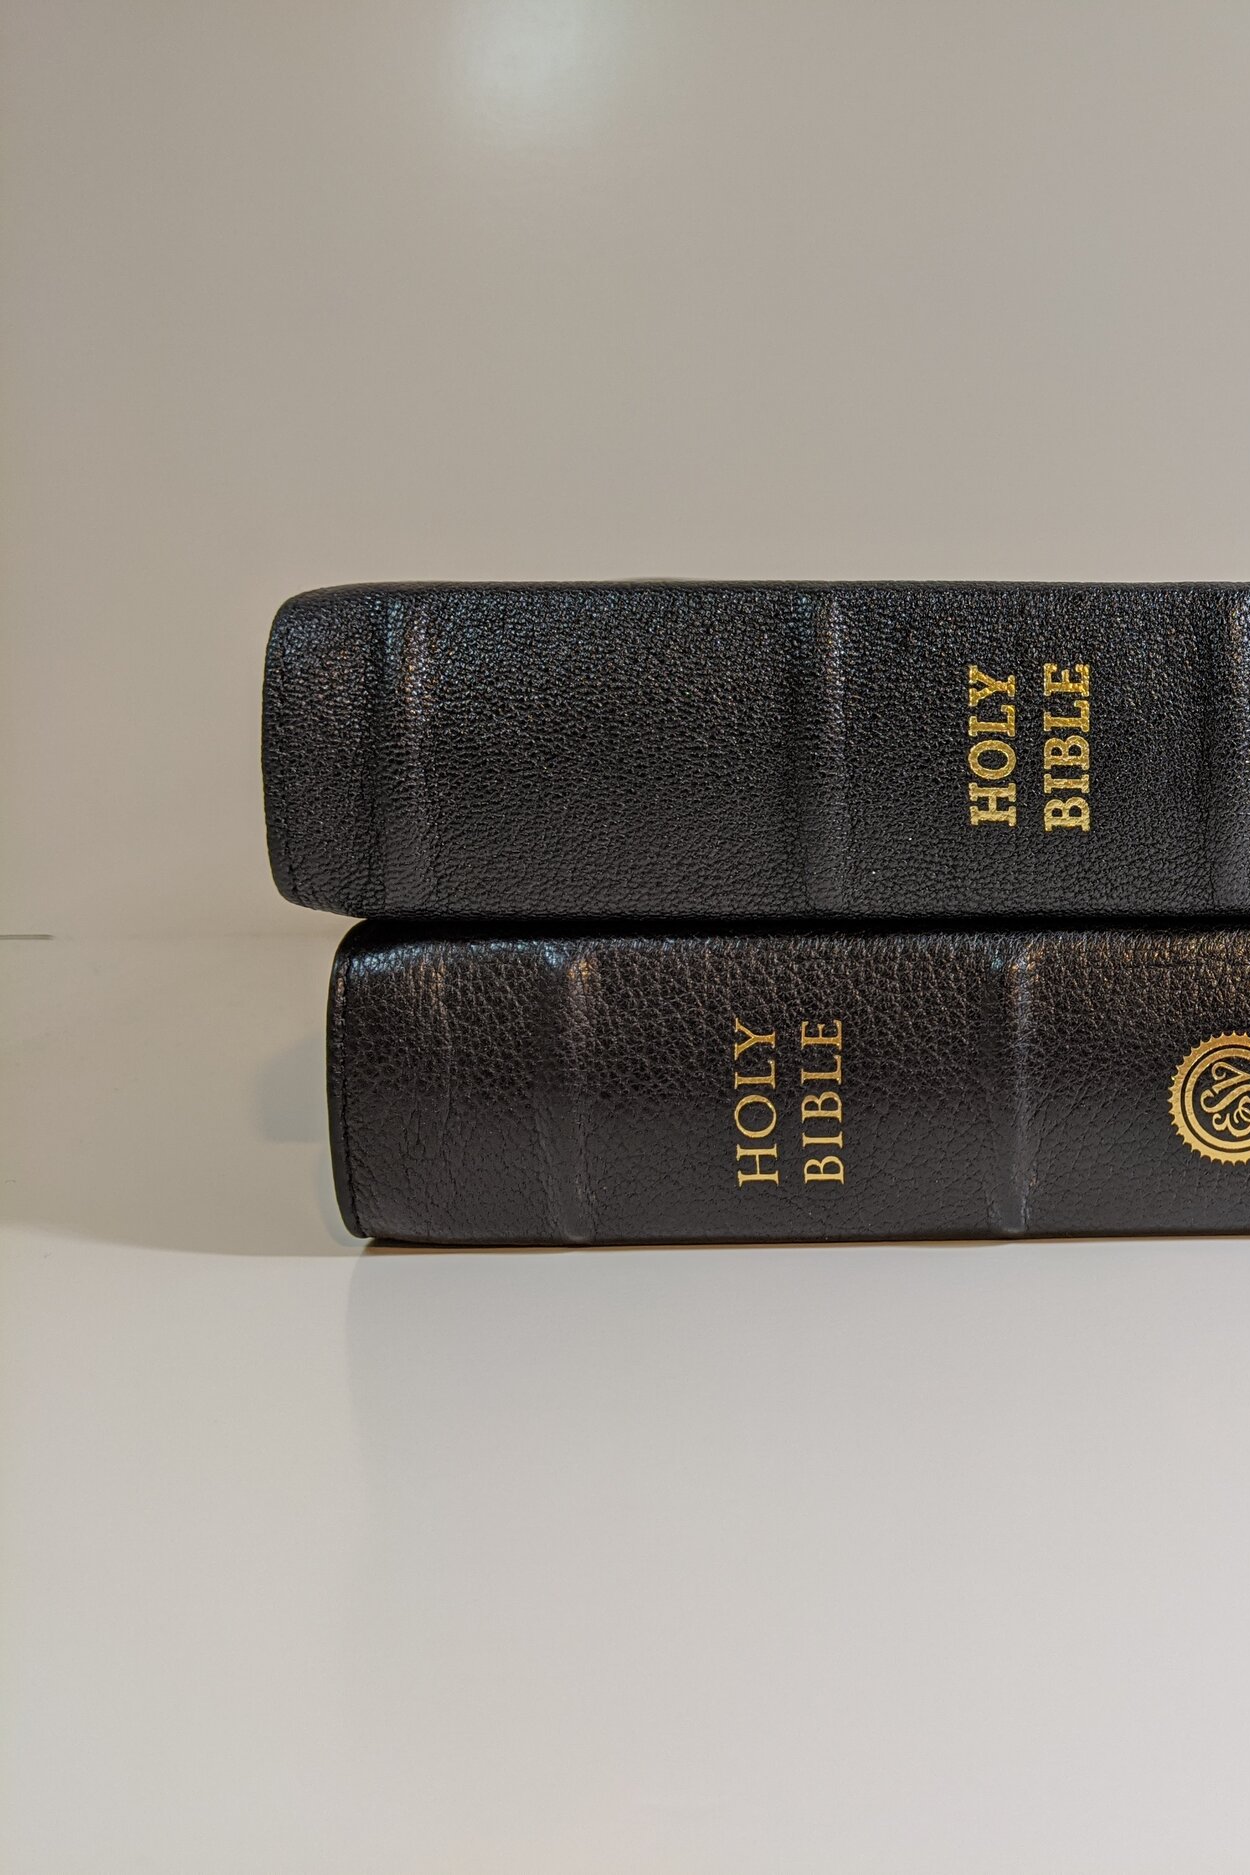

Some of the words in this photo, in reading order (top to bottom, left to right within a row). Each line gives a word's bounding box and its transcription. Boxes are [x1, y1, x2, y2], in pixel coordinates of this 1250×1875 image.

[968, 664, 1018, 828] HOLY
[1044, 662, 1091, 833] BIBLE
[734, 1018, 780, 1186] HOLY
[801, 1018, 845, 1185] BIBLE
